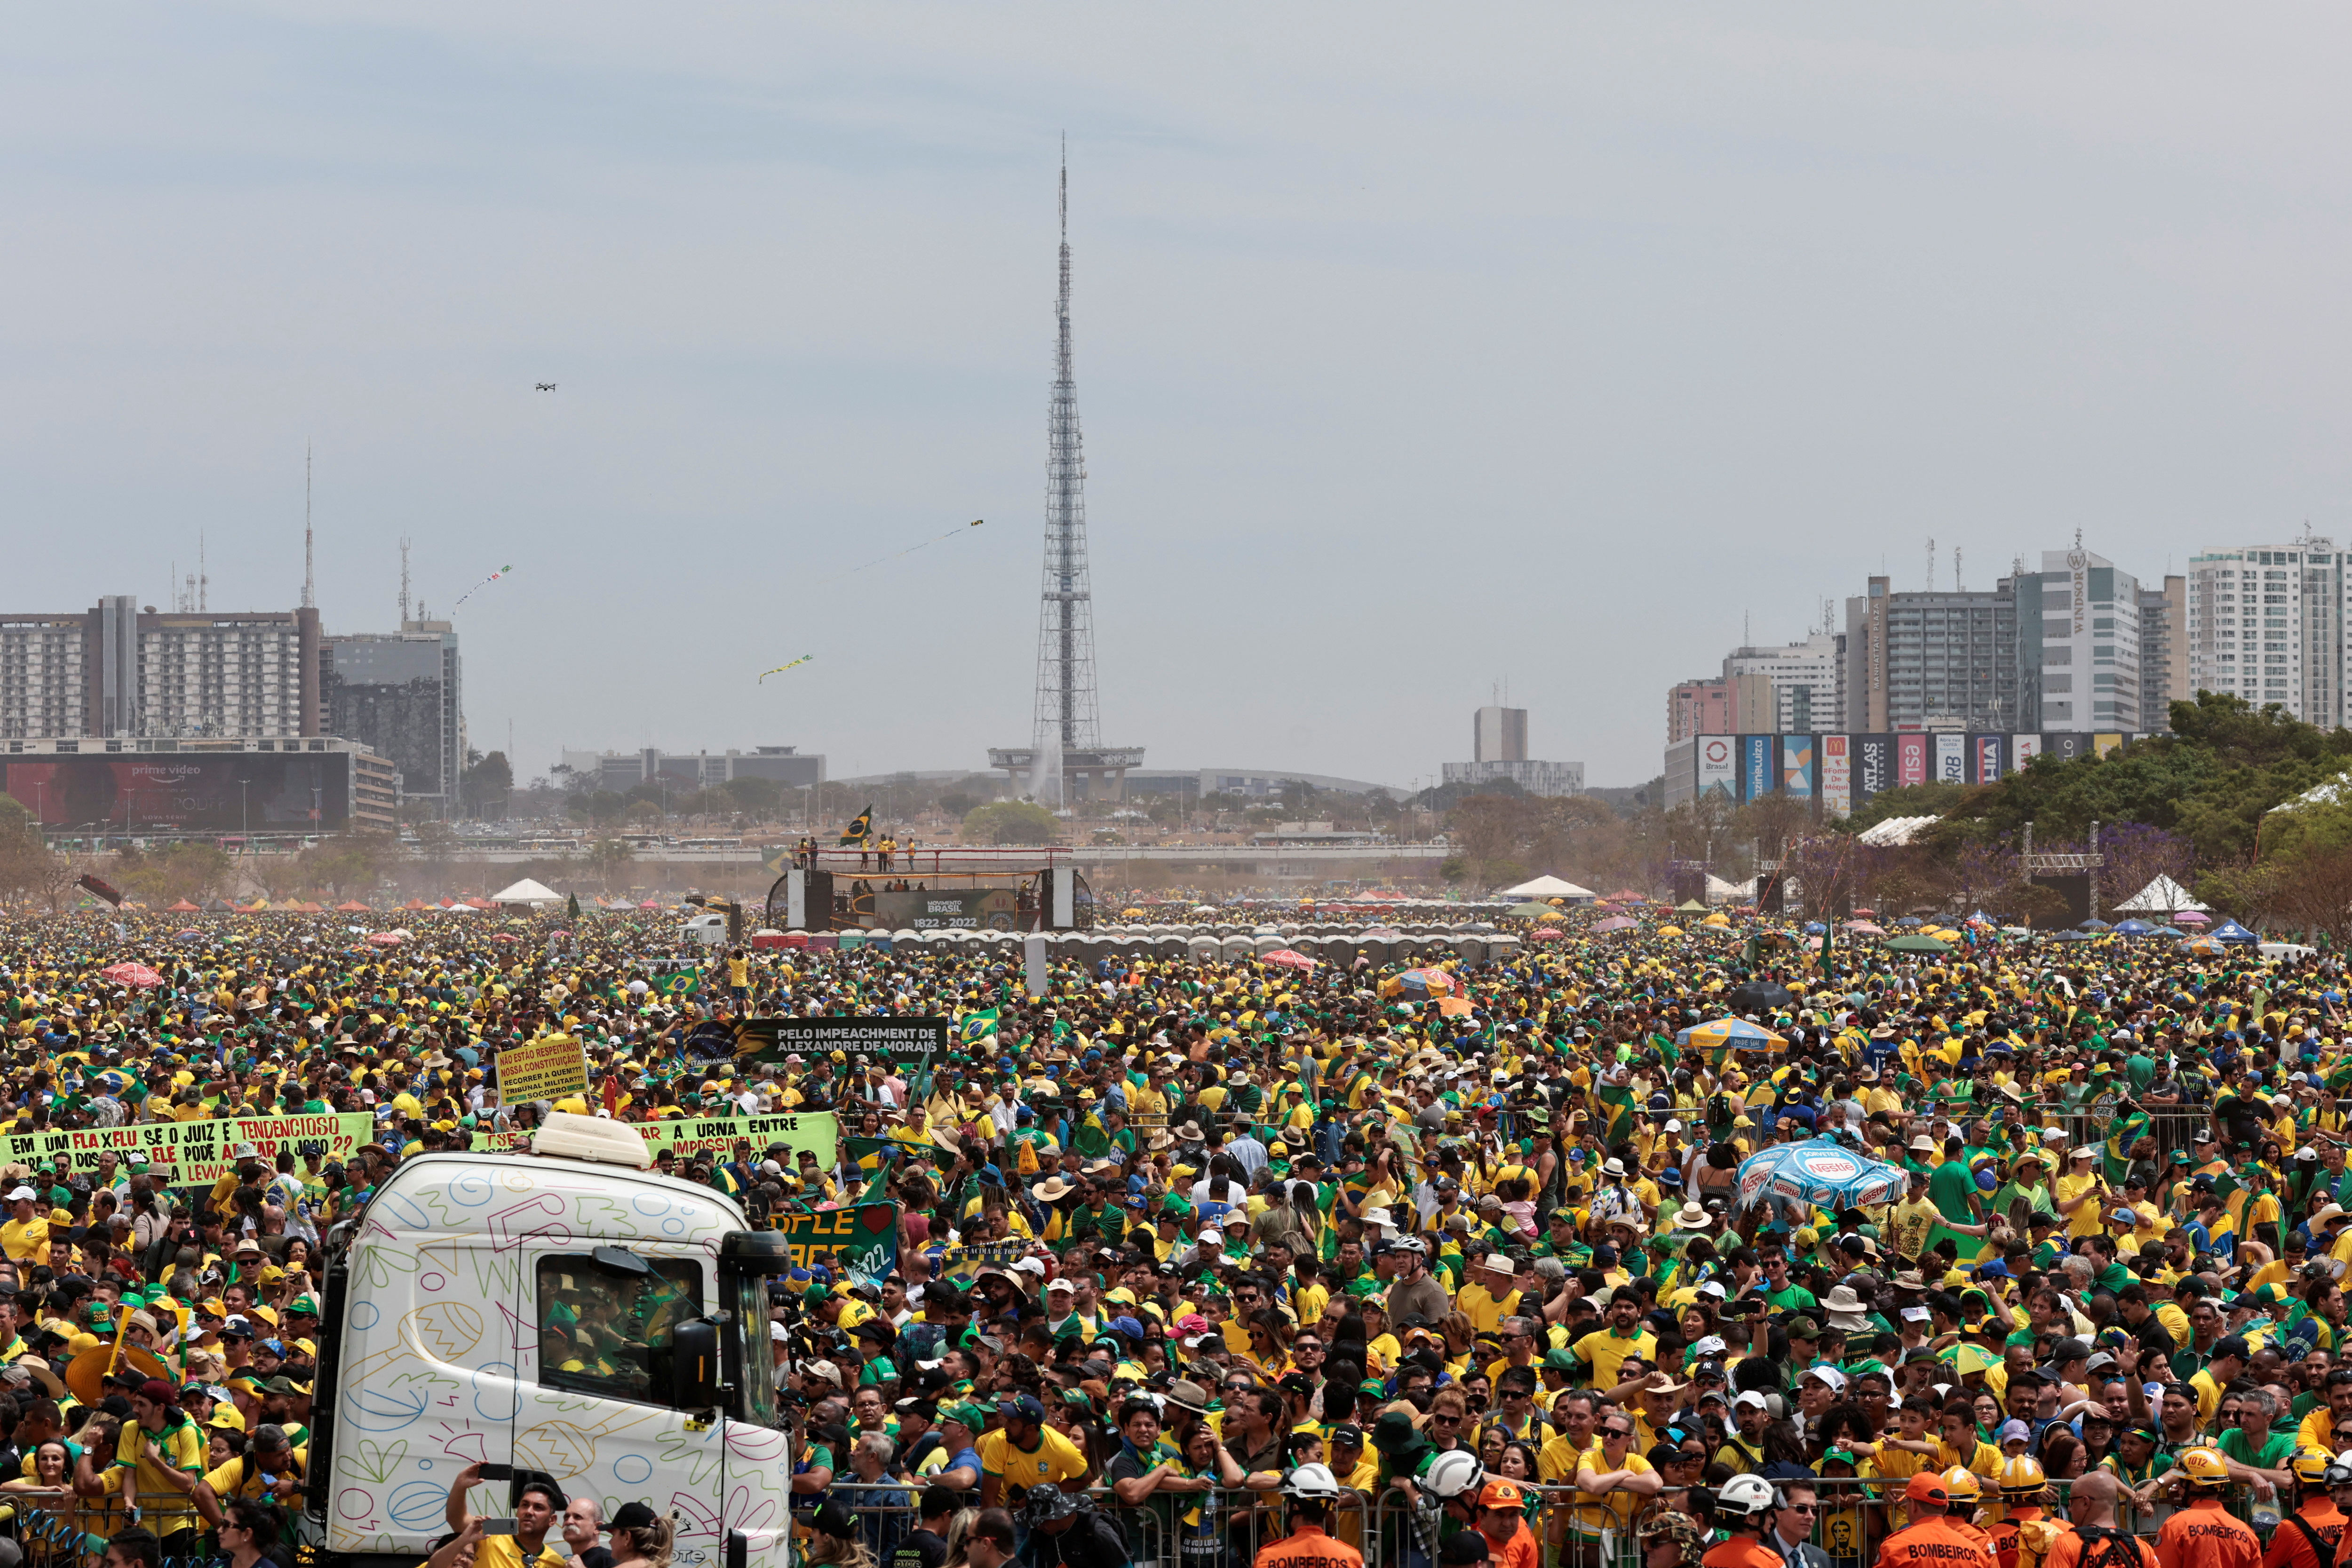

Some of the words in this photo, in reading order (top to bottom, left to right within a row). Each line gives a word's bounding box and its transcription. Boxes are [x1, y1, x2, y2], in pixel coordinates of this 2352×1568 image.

[2074, 572, 2083, 634] WINDSOR
[2064, 740, 2074, 762] LO
[1864, 743, 1877, 793] ATLAS
[1984, 743, 1996, 781] HIA
[132, 765, 166, 777] prime
[168, 765, 201, 774] video
[1825, 783, 1849, 792] Méqui
[914, 918, 939, 928] 1822
[948, 918, 977, 928] 2022
[778, 1029, 812, 1039] PELO
[816, 1028, 917, 1039] IMPEACHMENT
[919, 1028, 936, 1039] DE
[778, 1041, 860, 1052] ALEXANDRE
[863, 1041, 881, 1052] DE
[885, 1041, 938, 1053] MORAIS
[500, 1054, 513, 1067] NÃO
[514, 1049, 534, 1063] ESTÃO
[536, 1042, 580, 1058] RESPEITANDO
[501, 1067, 524, 1078] NOSSA
[524, 1053, 582, 1072] CONSTITUIÇÃO!!!
[691, 1057, 732, 1067] ITANHANGÁ
[504, 1073, 542, 1087] RECORRER
[551, 1066, 582, 1078] QUEM???
[505, 1084, 542, 1095] TRIBUNAL
[544, 1075, 583, 1090] MILITAR???
[527, 1086, 567, 1099] SOCORRO
[10, 1137, 35, 1154] EM
[44, 1134, 70, 1152] UM
[72, 1132, 99, 1149] FLA
[113, 1130, 137, 1147] FLU
[144, 1127, 163, 1146] SE
[169, 1127, 178, 1144] O
[183, 1122, 215, 1143] JUIZ
[237, 1116, 340, 1140] TENDENCIOSO
[634, 1126, 661, 1140] AR
[674, 1125, 683, 1139] A
[697, 1122, 738, 1138] URNA
[749, 1117, 798, 1133] ENTRE
[486, 1131, 516, 1147] TSE
[151, 1146, 177, 1164] ELE
[184, 1143, 215, 1162] PODE
[333, 1135, 353, 1157] ??
[1808, 1162, 1855, 1174] Nestlé
[1779, 1173, 1802, 1186] SORVETES
[1855, 1177, 1876, 1190] SORVETES
[1773, 1182, 1800, 1199] Nestlé
[1813, 1190, 1830, 1201] Nestlé
[1857, 1182, 1888, 1205] Nestlé
[1898, 1223, 1919, 1236] Brasil
[866, 1243, 891, 1274] 22
[1554, 1253, 1584, 1262] ENDÊNCIA
[94, 1313, 109, 1322] 2022
[1846, 1333, 1874, 1342] dependência
[2188, 1456, 2208, 1468] 1012
[2188, 1524, 2248, 1543] BOMBEIROS
[896, 1549, 921, 1558] PRODUÇÃO
[1908, 1543, 1978, 1563] BOMBEIROS
[2087, 1552, 2140, 1568] BOBEOS
[1268, 1555, 1349, 1568] BOMBEIROS
